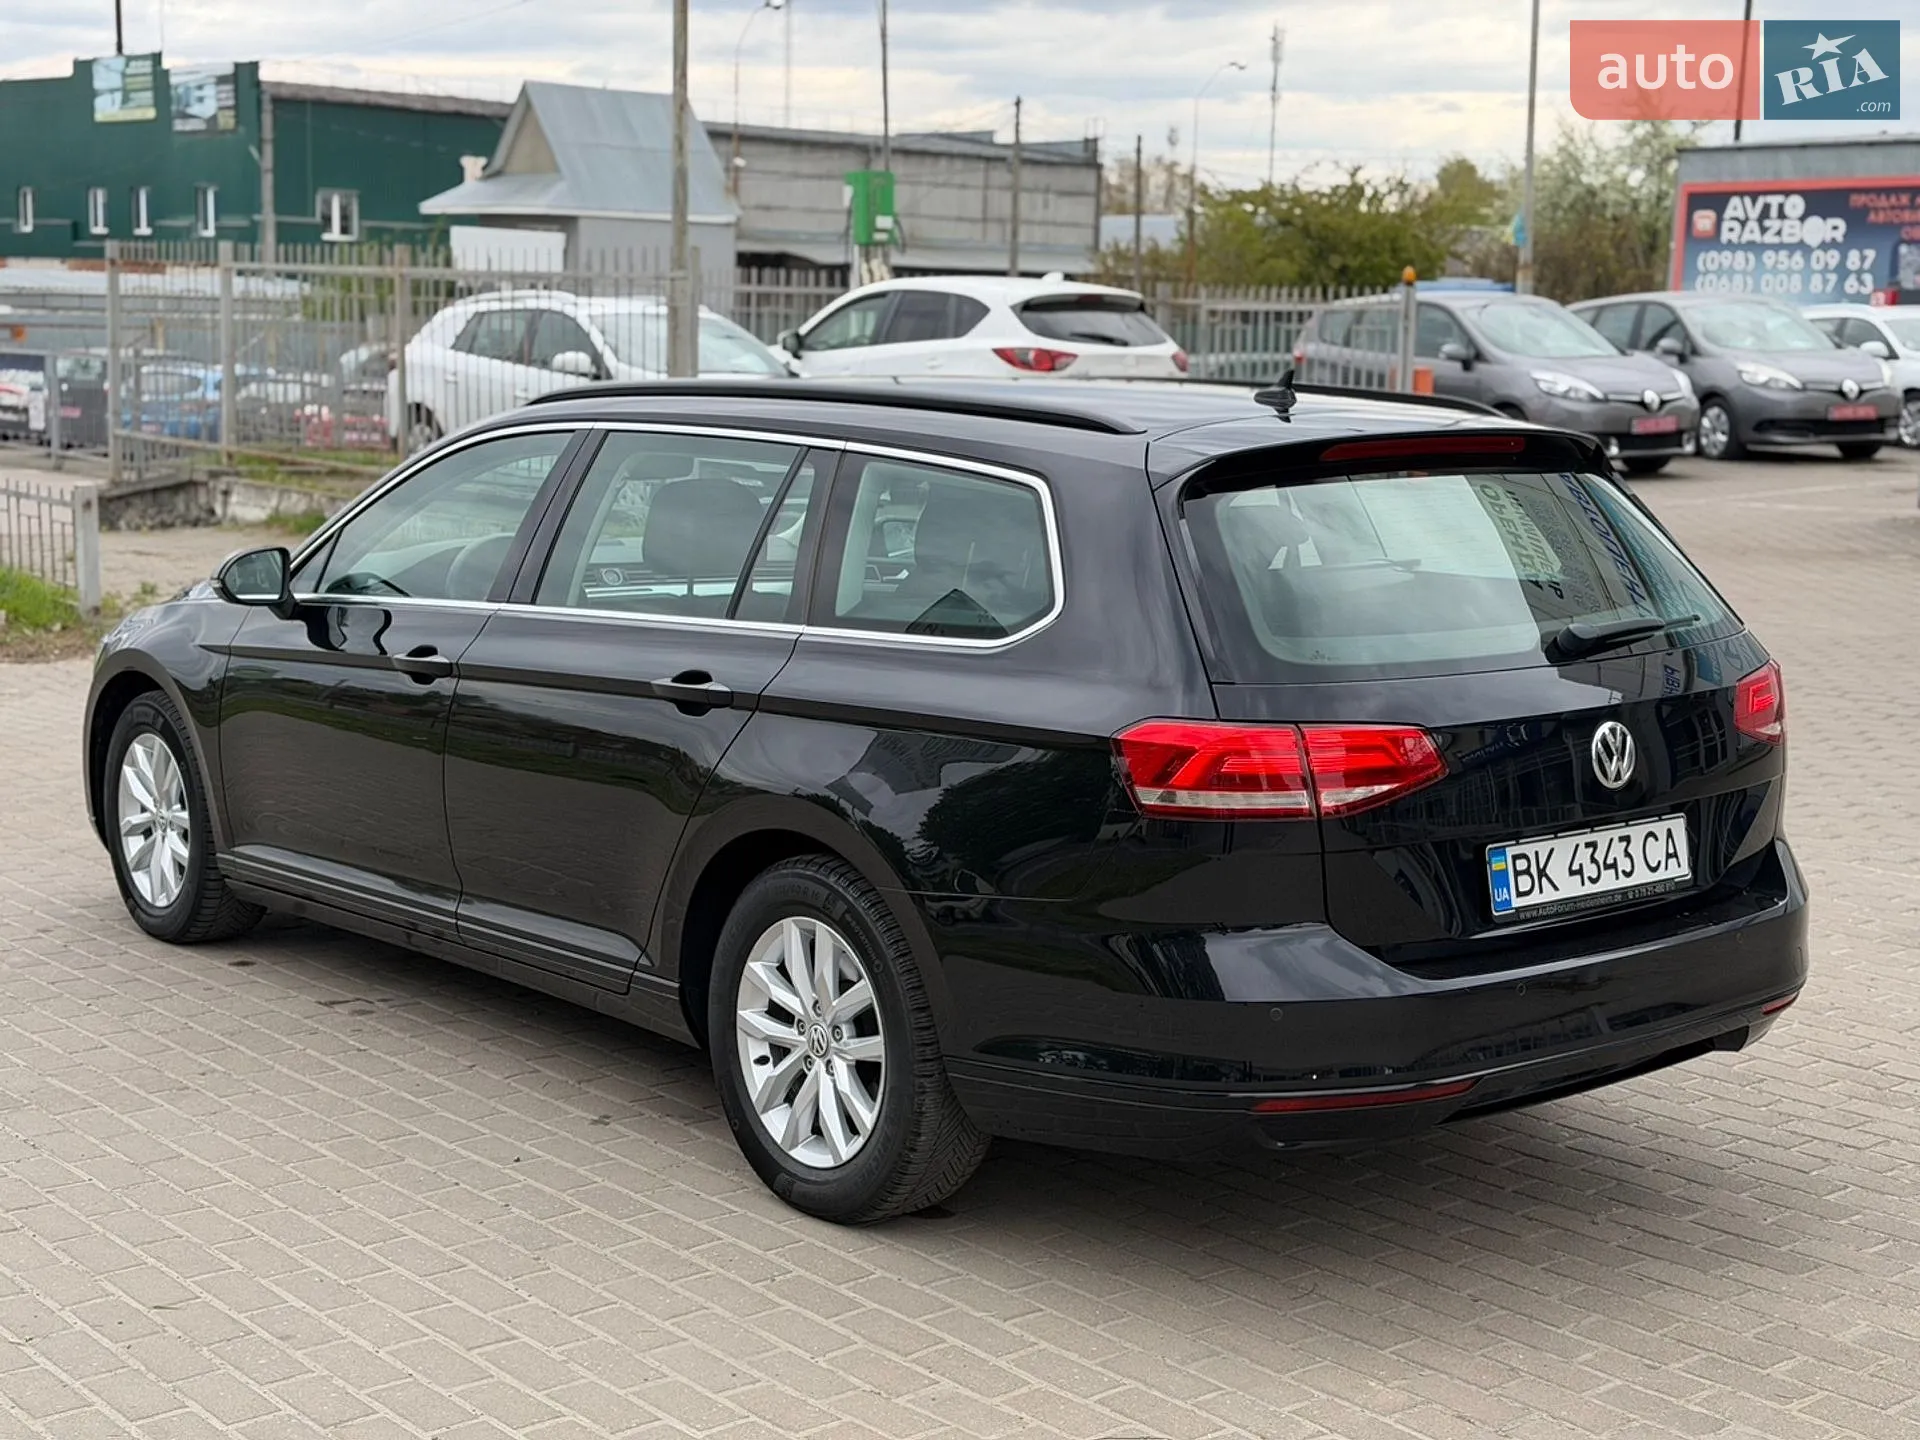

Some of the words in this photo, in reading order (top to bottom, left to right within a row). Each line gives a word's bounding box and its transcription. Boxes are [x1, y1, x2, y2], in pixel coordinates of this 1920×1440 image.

[1722, 194, 1806, 220] AVTO
[1720, 216, 1847, 248] RAZBOR
[1697, 249, 1755, 272] (098)
[1762, 249, 1804, 271] 956
[1811, 249, 1840, 271] 09
[1846, 248, 1876, 271] 87
[1695, 273, 1753, 294] (068)
[1761, 273, 1802, 294] 008
[1810, 272, 1838, 294] 87
[1844, 272, 1874, 294] 63
[1511, 847, 1560, 898] BK
[1568, 834, 1635, 887] 4343
[1643, 827, 1681, 873] CA
[1495, 886, 1510, 902] UA
